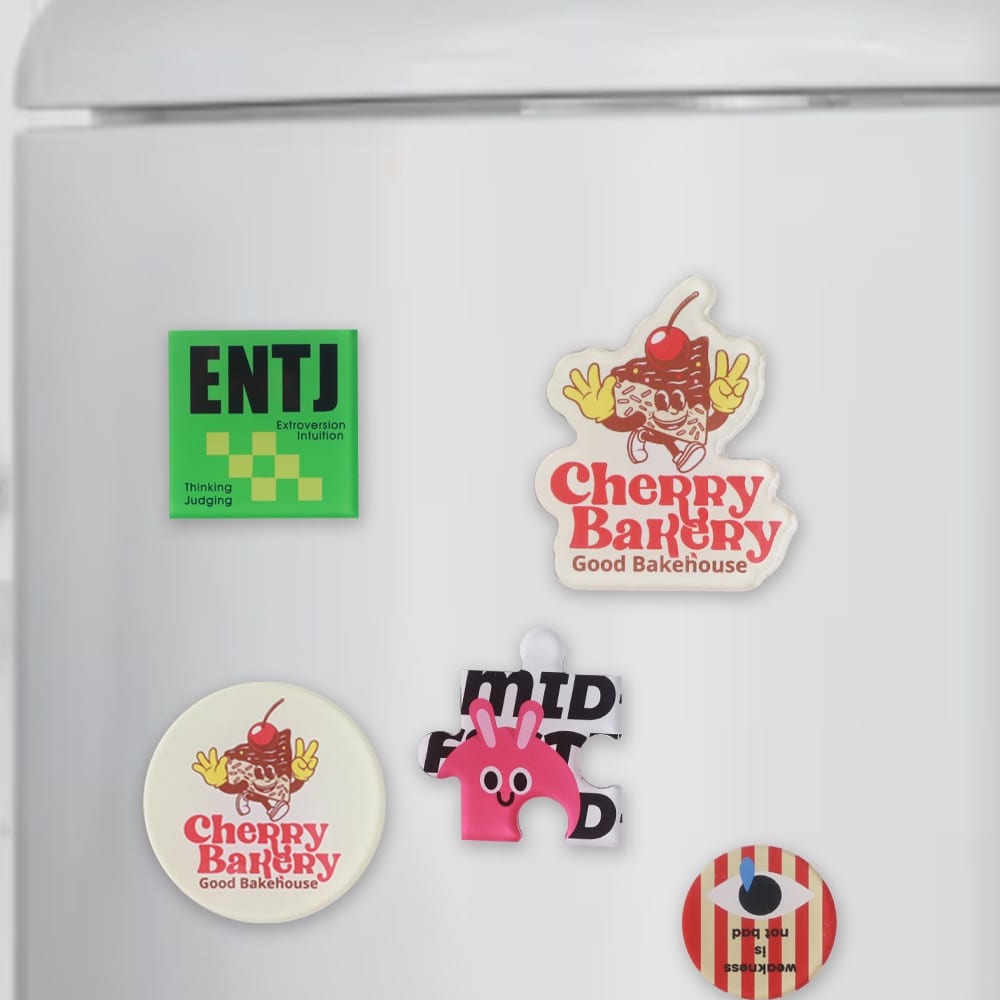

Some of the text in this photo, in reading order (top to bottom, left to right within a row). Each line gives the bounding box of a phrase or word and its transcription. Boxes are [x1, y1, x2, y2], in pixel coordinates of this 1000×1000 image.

[190, 344, 338, 414] ENTJ
[276, 420, 346, 430] Extroversion
[297, 431, 344, 441] Intuition
[184, 483, 233, 494] Thinking
[550, 462, 765, 519] Cherry
[184, 496, 233, 508] Judging
[569, 506, 783, 563] Bakery
[572, 555, 748, 574] Good Bakehouse
[183, 815, 329, 851] Cherry
[197, 844, 341, 882] Bakery
[199, 877, 319, 890] Good Bakehouse
[732, 928, 789, 940] not bad
[754, 945, 767, 958] is
[723, 963, 797, 975] weakness
